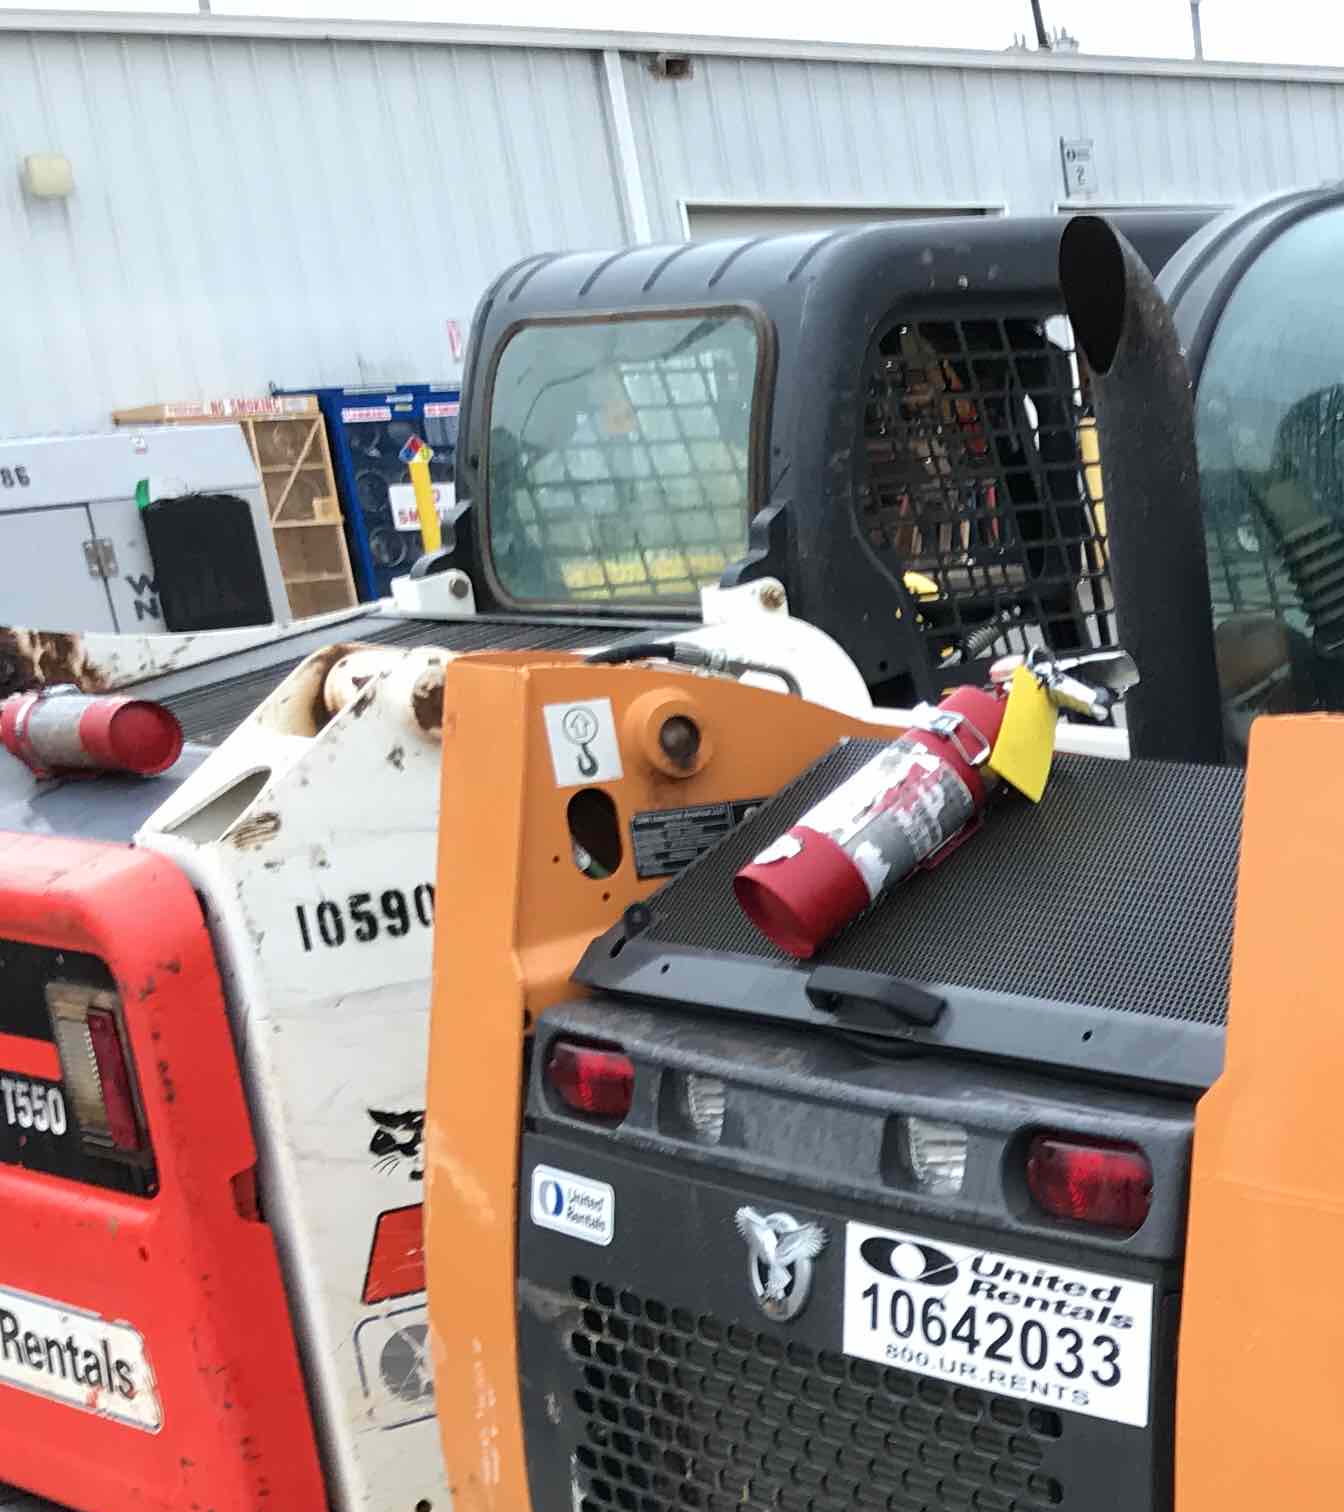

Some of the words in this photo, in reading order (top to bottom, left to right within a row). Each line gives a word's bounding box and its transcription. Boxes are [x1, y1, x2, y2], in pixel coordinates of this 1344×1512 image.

[1, 1078, 67, 1135] T550
[968, 1279, 1135, 1330] Rentals
[970, 1254, 1122, 1303] United
[0, 1308, 136, 1400] Rentals
[862, 1282, 1122, 1387] 10642033
